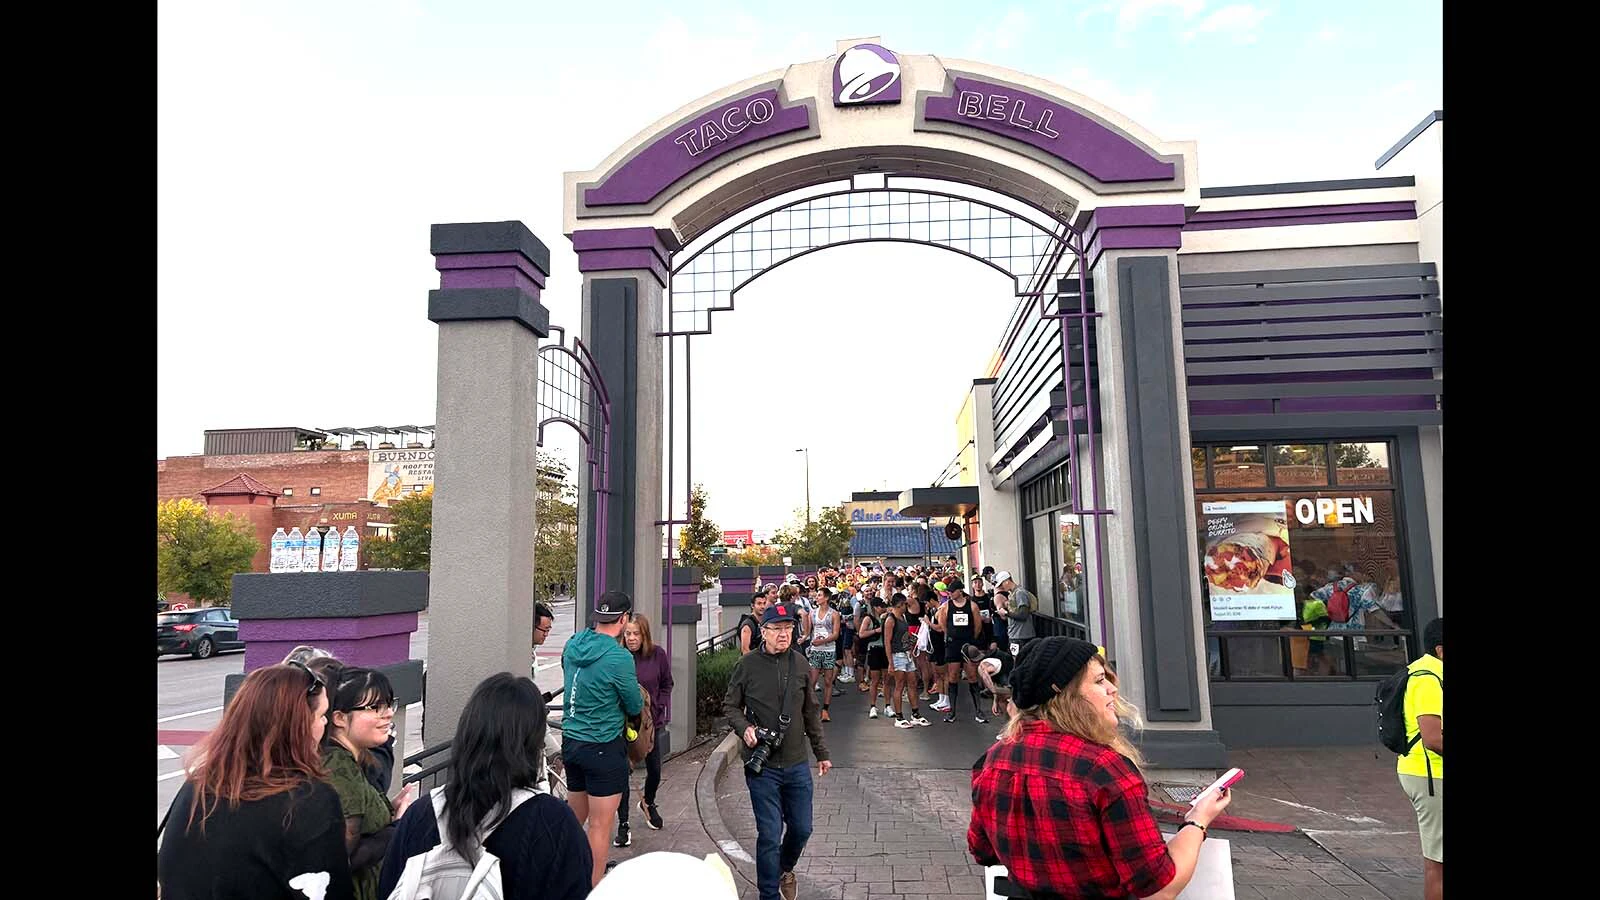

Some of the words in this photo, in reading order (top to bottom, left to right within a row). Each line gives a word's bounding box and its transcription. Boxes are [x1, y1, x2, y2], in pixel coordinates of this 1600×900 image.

[674, 98, 774, 156] TACO
[957, 90, 1059, 139] BELL
[332, 511, 358, 521] XUMA
[851, 508, 882, 521] Blue
[1295, 498, 1375, 525] OPEN
